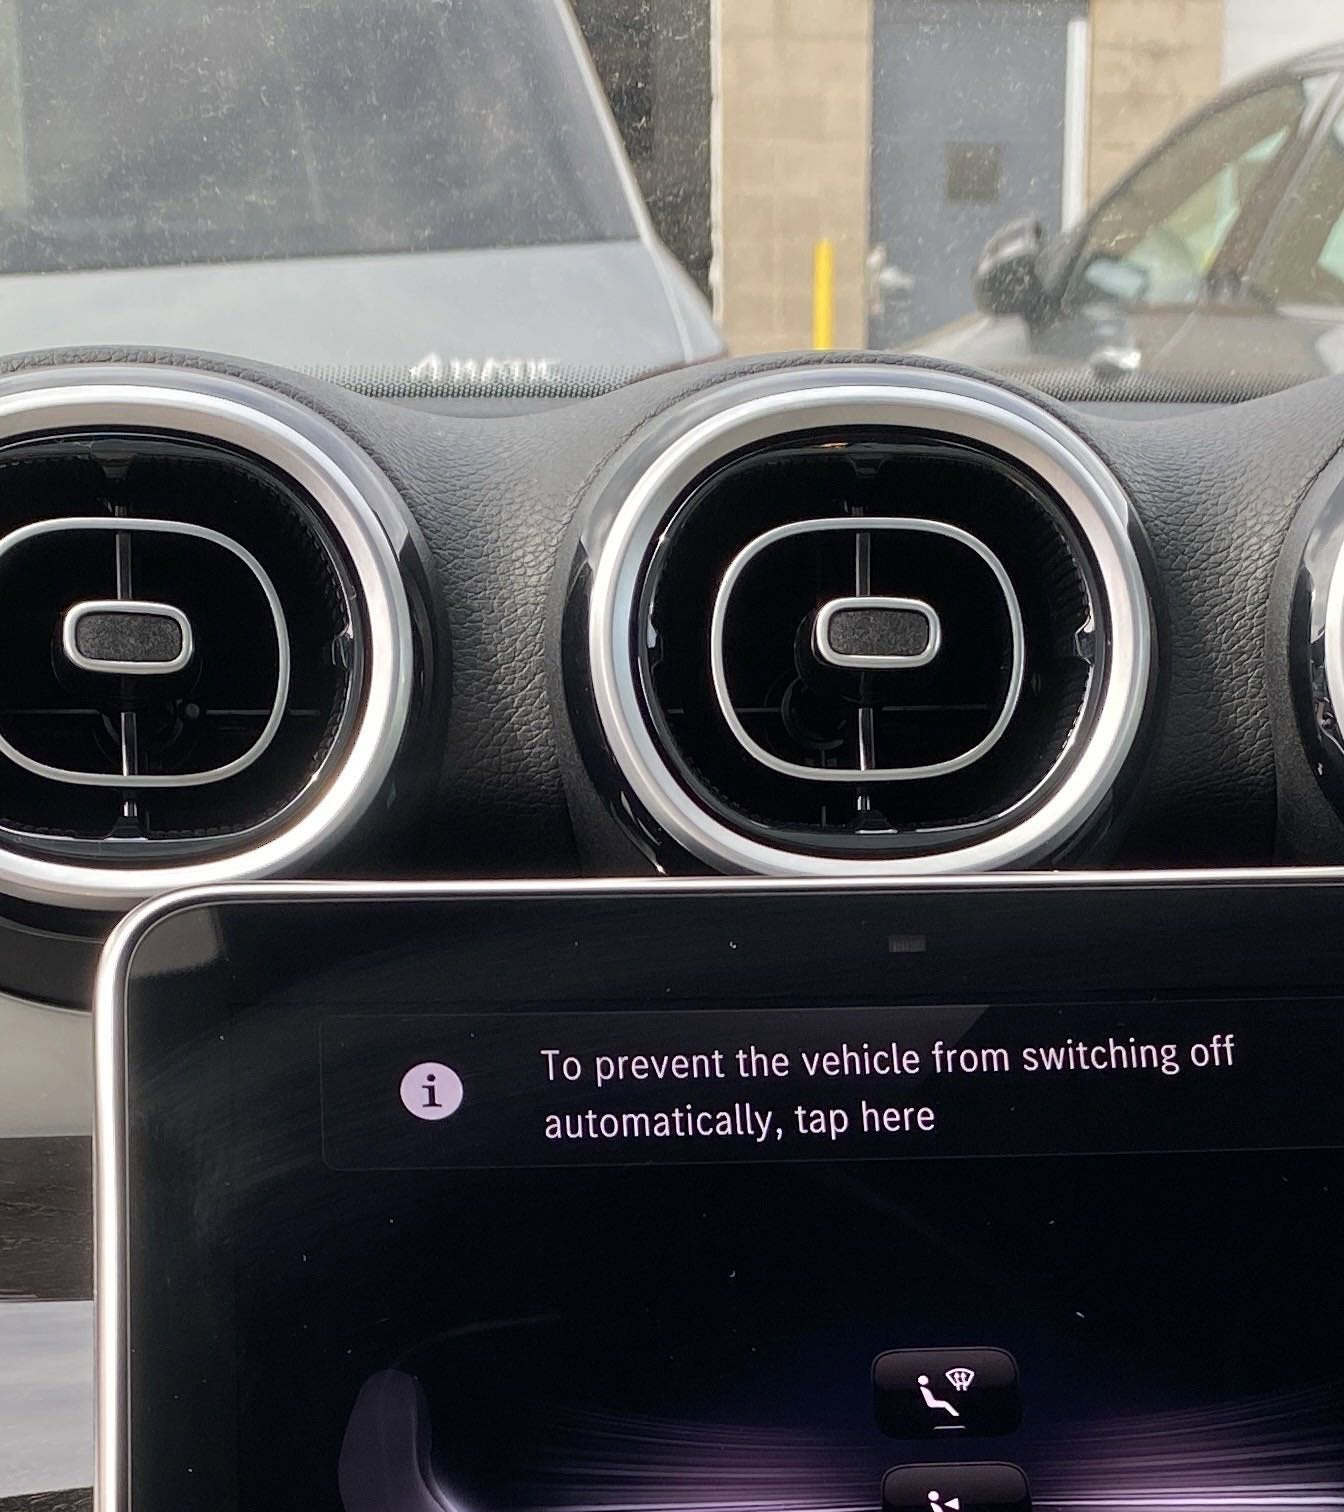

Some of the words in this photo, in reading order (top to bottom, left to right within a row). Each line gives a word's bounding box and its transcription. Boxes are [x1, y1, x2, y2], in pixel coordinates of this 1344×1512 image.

[540, 1049, 582, 1081] To
[596, 1049, 726, 1088] prevent
[735, 1045, 789, 1078] the
[801, 1042, 920, 1076] vehicle
[931, 1040, 1010, 1073] from
[1022, 1035, 1180, 1075] switching
[1190, 1034, 1235, 1067] off
[545, 1102, 783, 1143] automatically,
[794, 1105, 849, 1141] tap
[861, 1100, 935, 1132] here
